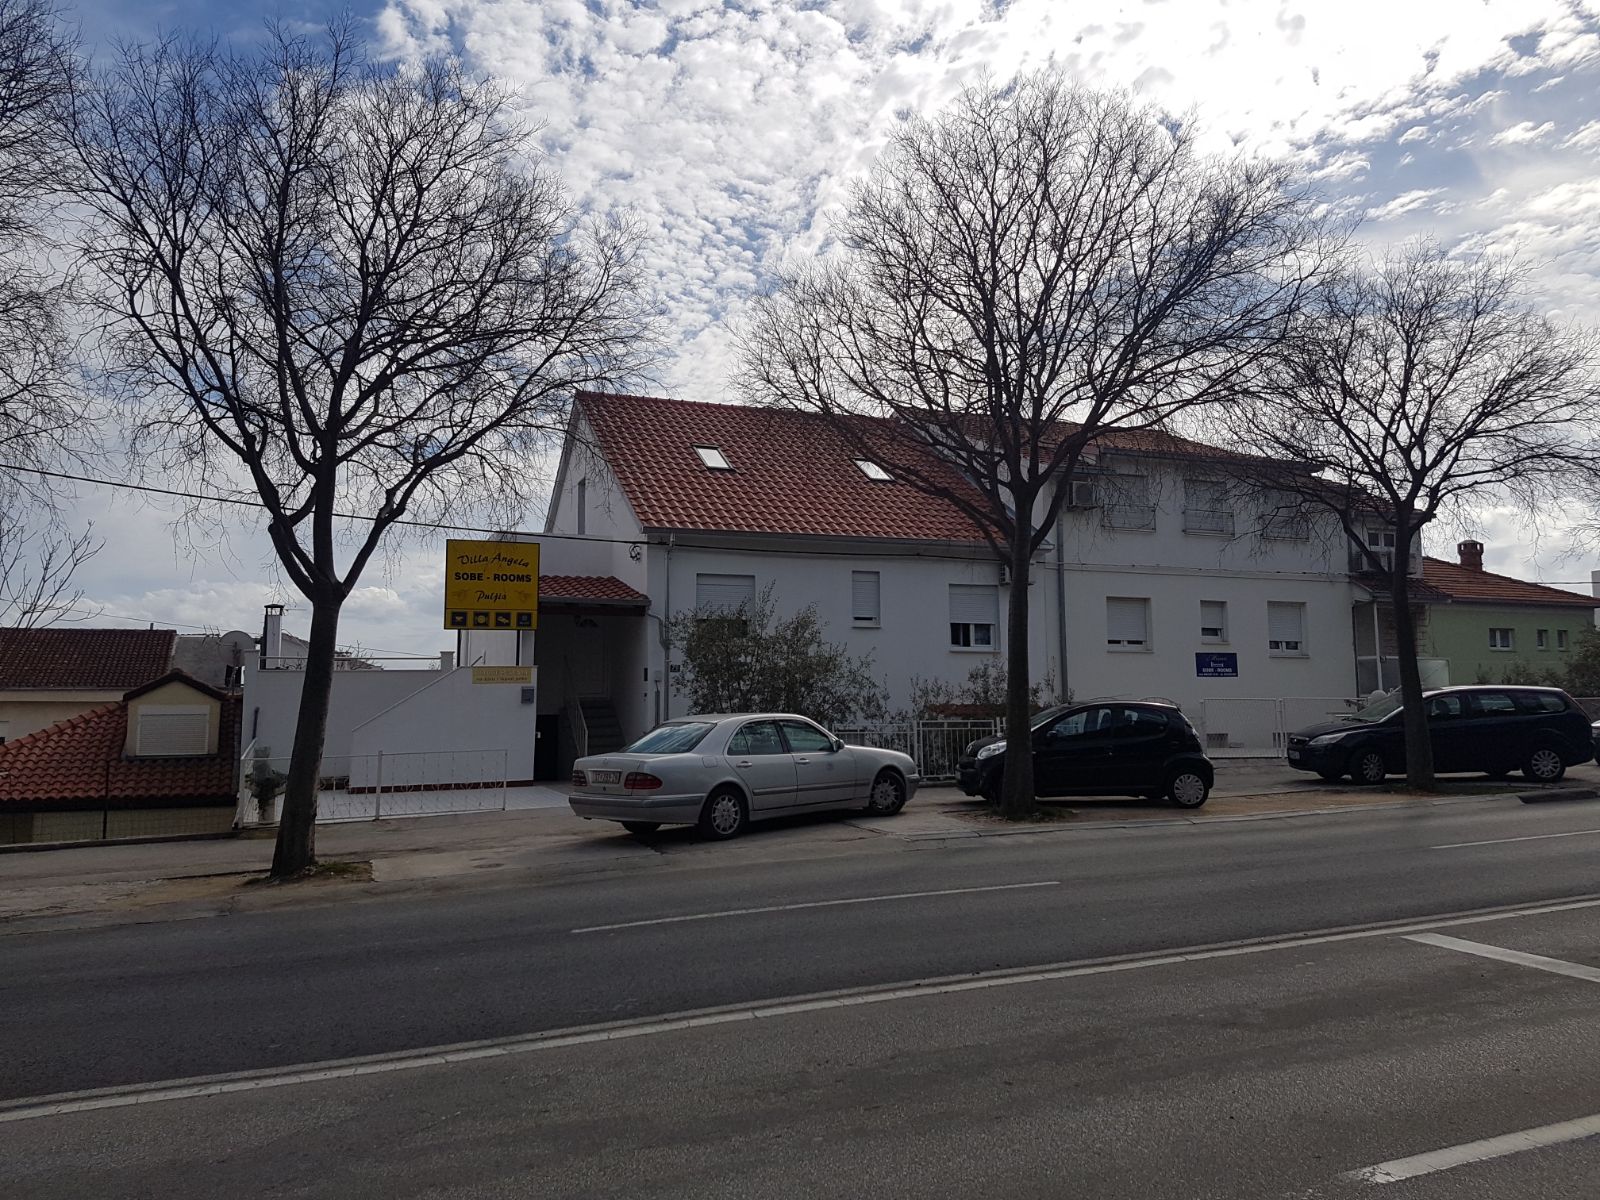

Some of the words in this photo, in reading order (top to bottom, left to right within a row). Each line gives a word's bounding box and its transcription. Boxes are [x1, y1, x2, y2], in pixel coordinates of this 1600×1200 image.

[457, 554, 489, 565] Villa
[491, 552, 530, 567] Angela
[454, 571, 484, 582] SOBE
[493, 572, 532, 583] ROOMS
